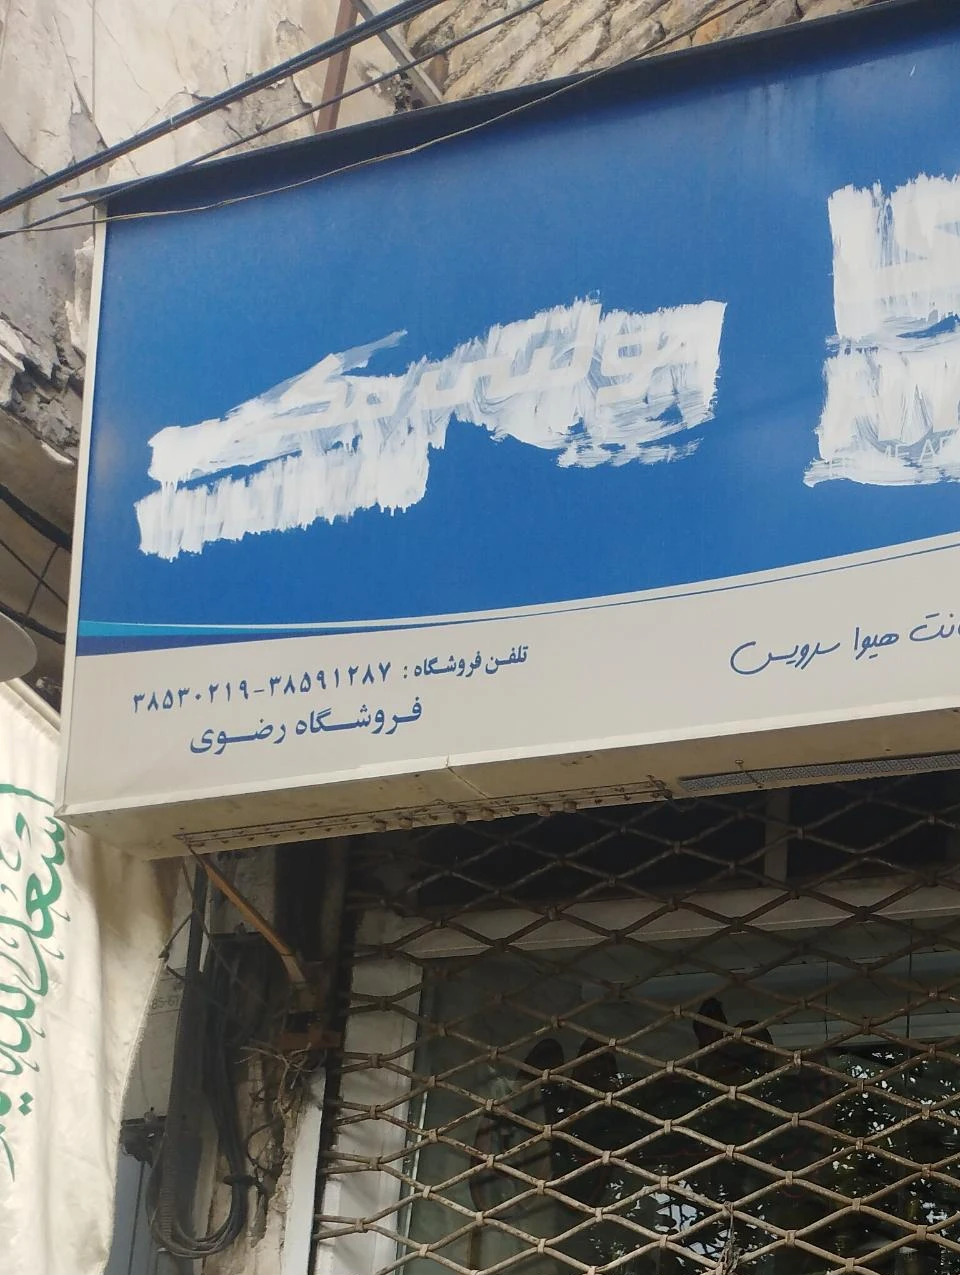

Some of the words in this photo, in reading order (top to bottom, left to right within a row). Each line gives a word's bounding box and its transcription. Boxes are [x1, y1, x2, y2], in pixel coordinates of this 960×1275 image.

[486, 643, 530, 674] تلفن
[730, 640, 841, 675] سرویس
[853, 626, 900, 660] هیوا
[413, 650, 483, 678] فروشگاه
[295, 695, 423, 736] فروشگاه
[189, 722, 287, 756] رضوی
